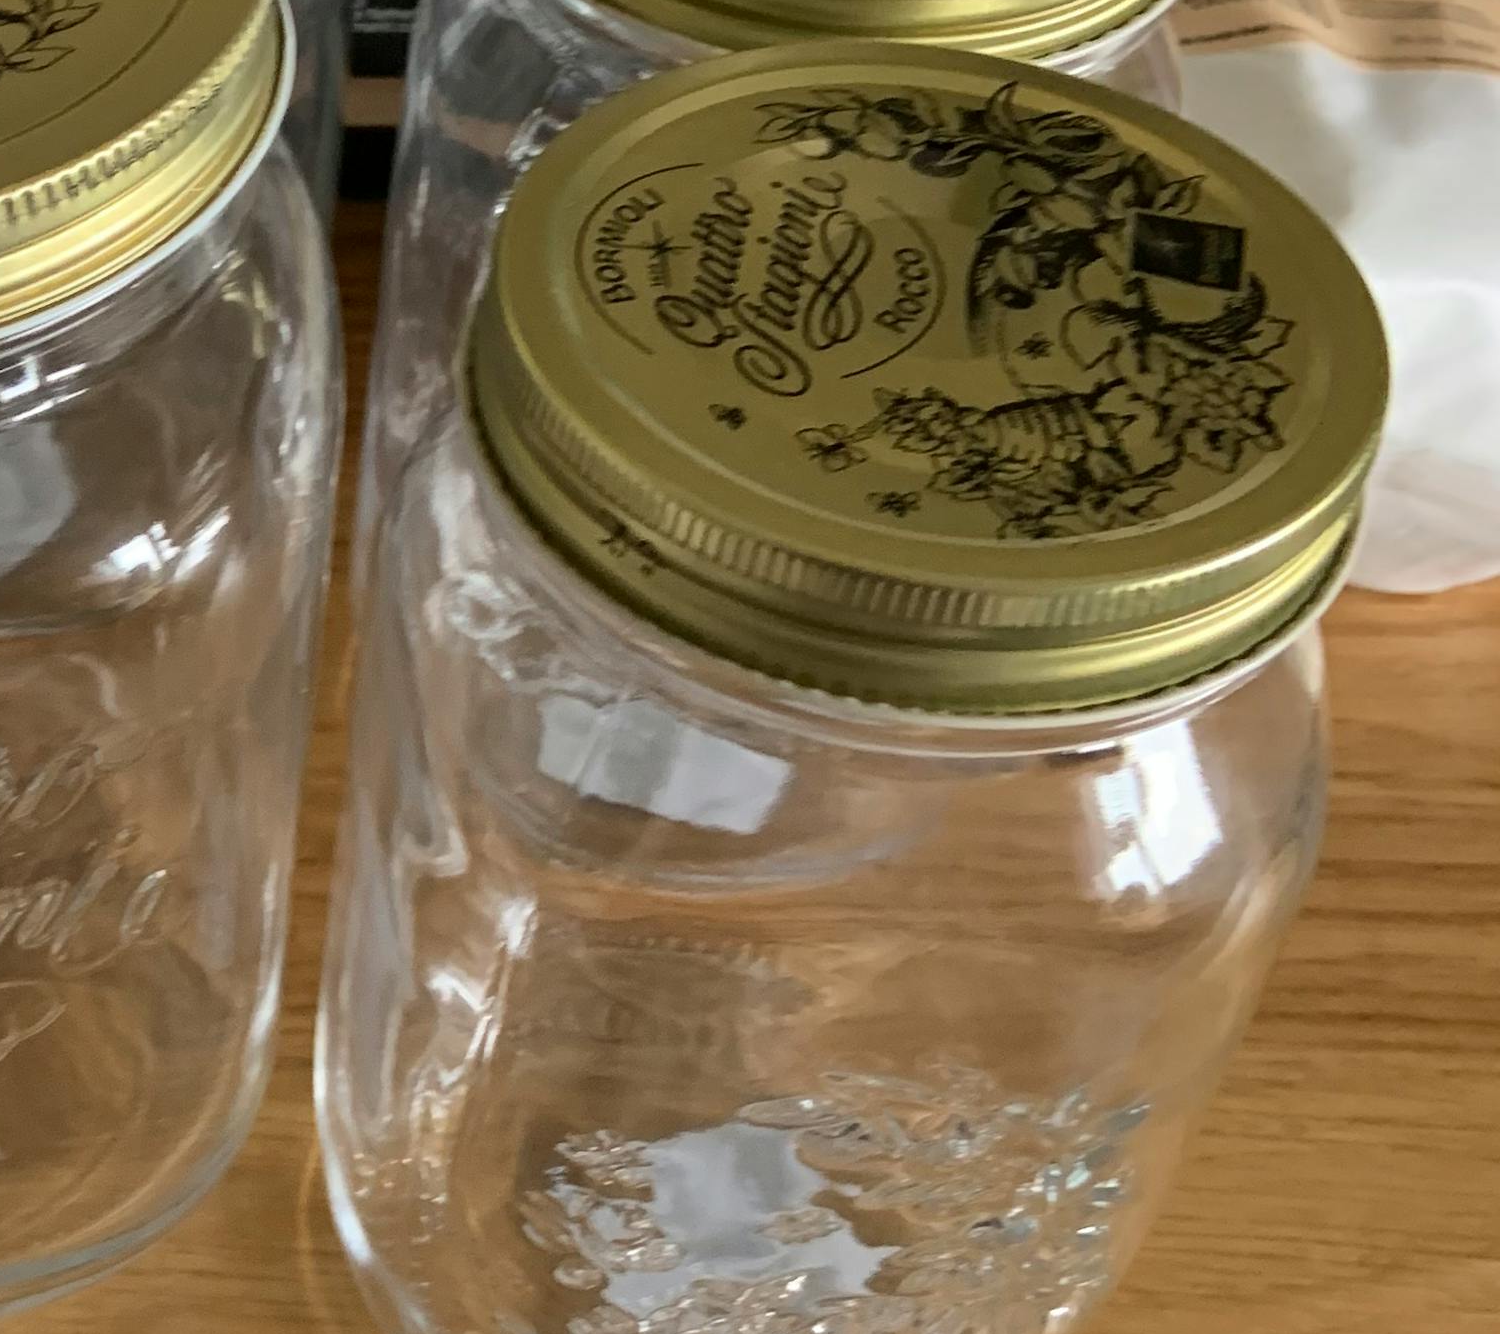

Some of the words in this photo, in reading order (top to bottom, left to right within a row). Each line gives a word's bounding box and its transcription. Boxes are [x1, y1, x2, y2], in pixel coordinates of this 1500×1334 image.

[594, 188, 665, 304] BORMIOLI
[654, 177, 754, 348] Quattro
[873, 247, 931, 333] ROCCO
